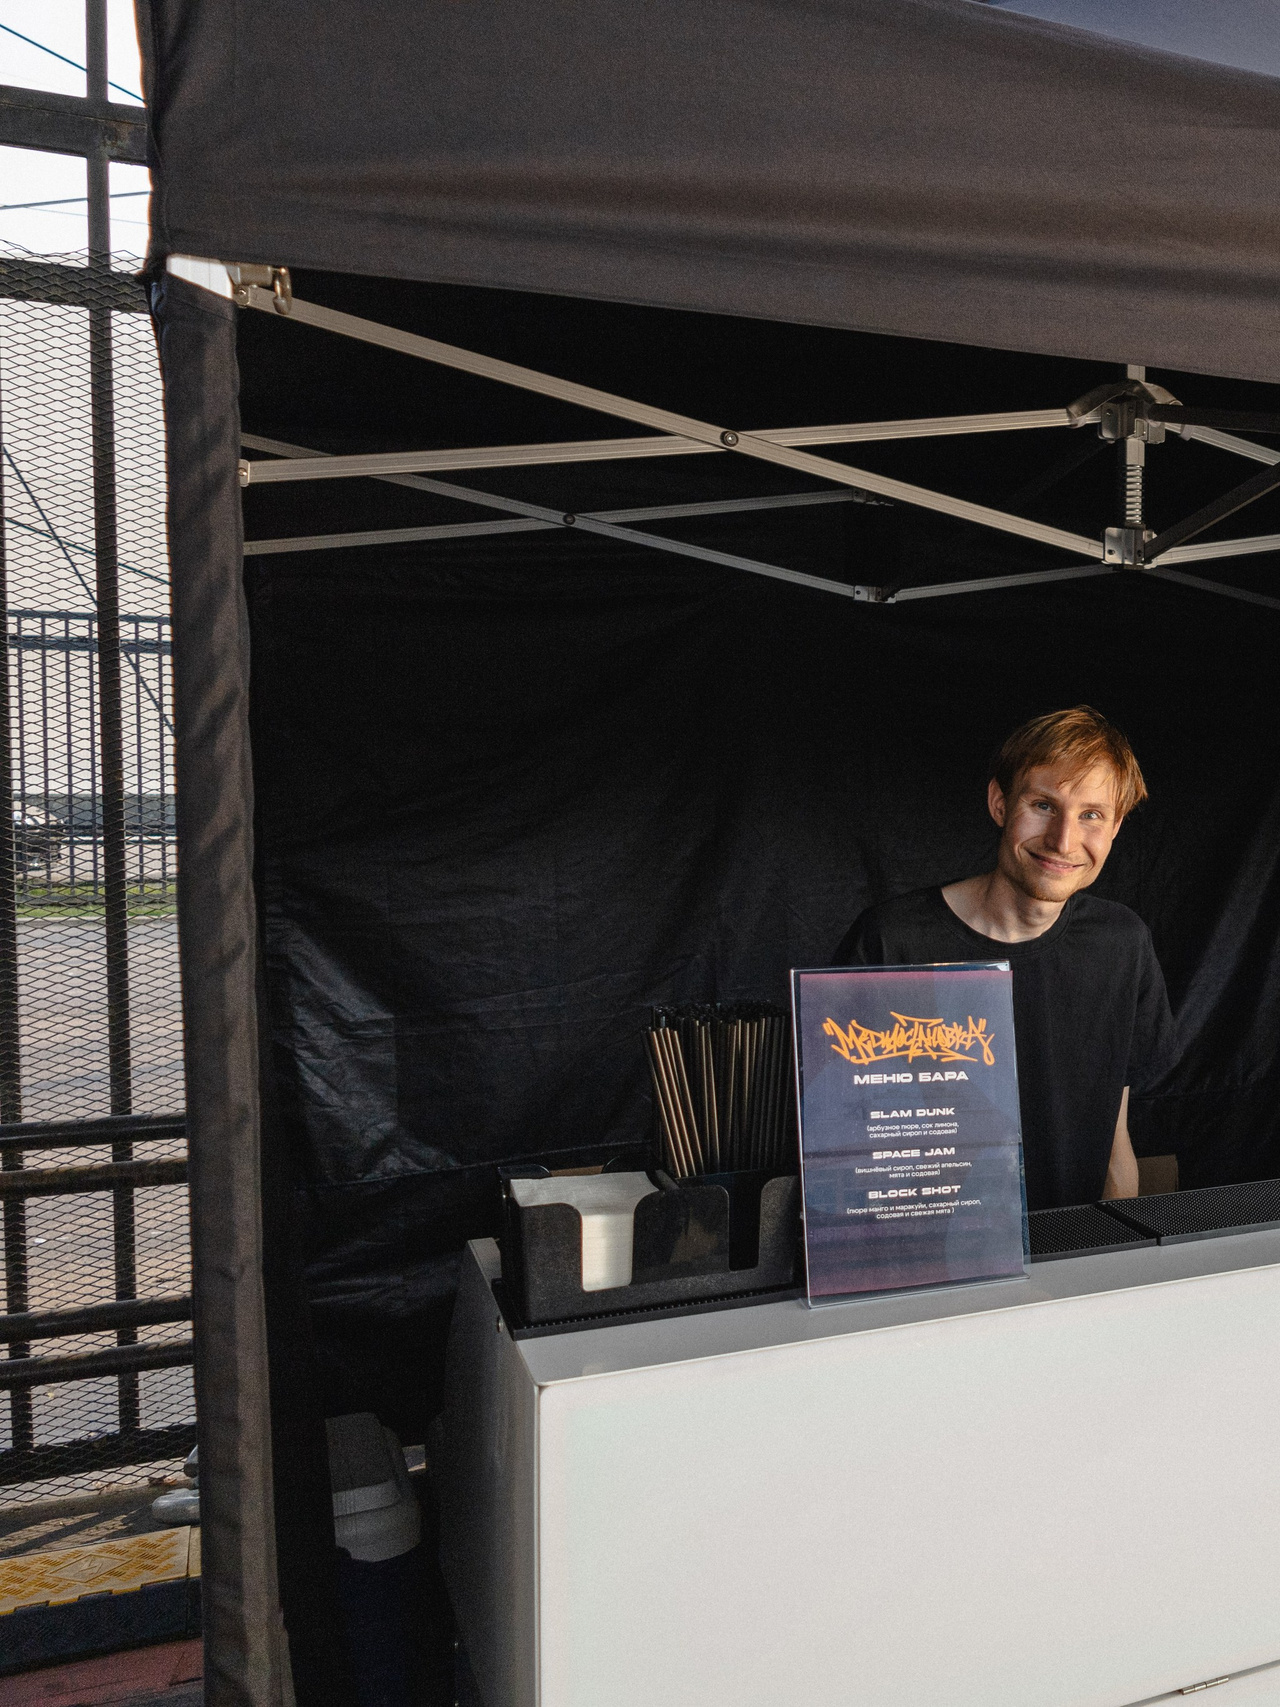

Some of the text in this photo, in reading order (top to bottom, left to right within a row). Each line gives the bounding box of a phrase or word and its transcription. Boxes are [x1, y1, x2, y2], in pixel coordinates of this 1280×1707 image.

[853, 1070, 969, 1085] МЕНЮ БАРА
[870, 1107, 955, 1119] SLAM DUNK
[866, 1124, 900, 1132] (арбузное
[869, 1131, 901, 1139] сахарный
[902, 1130, 923, 1138] сироп
[928, 1127, 958, 1135] содовая)
[872, 1147, 956, 1160] SPACE JAM
[892, 1164, 915, 1172] сироп,
[915, 1162, 941, 1170] свежий
[941, 1160, 973, 1169] апельсин,
[911, 1169, 941, 1178] содовая)
[868, 1185, 962, 1199] BLOCK SHOT
[846, 1207, 868, 1215] (пюре
[928, 1201, 960, 1209] сахарный
[910, 1209, 935, 1217] свежая
